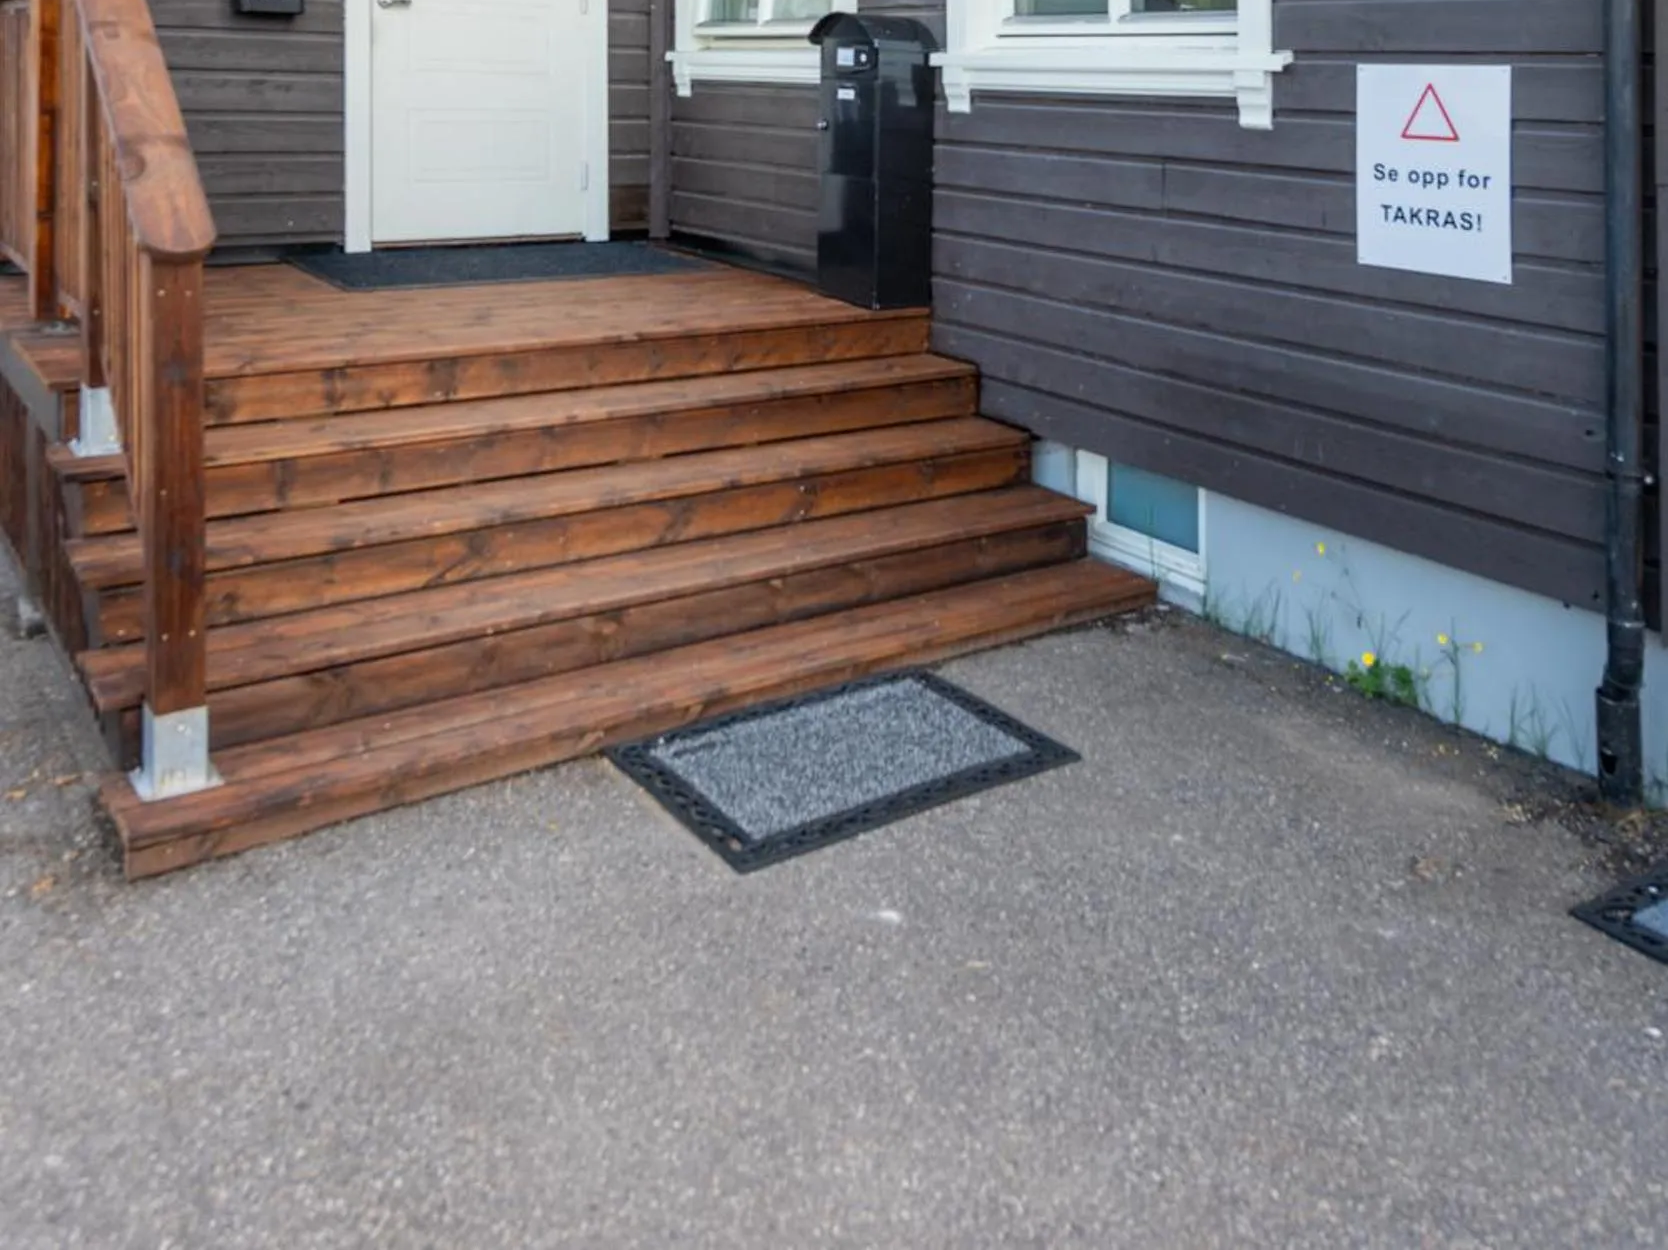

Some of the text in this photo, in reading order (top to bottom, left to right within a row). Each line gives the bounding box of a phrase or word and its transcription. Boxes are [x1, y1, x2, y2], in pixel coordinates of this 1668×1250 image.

[1373, 162, 1491, 190] Se opp for
[1380, 203, 1482, 232] TAKRAS!
